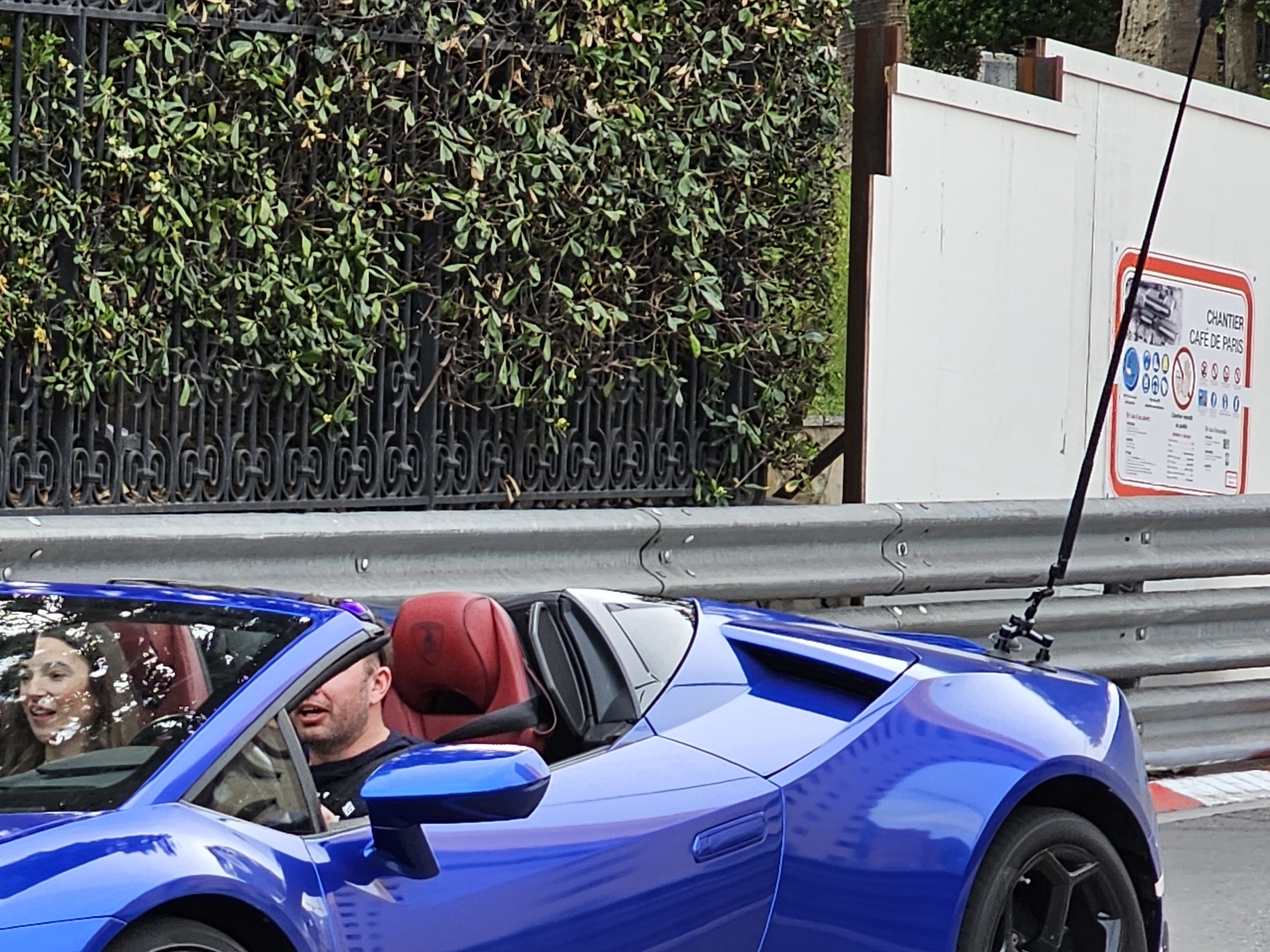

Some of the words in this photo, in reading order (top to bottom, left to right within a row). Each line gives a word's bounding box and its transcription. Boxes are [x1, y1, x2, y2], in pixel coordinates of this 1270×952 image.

[1206, 309, 1244, 331] CHANTIER
[1189, 328, 1209, 347] CAFÉ
[1210, 333, 1221, 349] DE
[1222, 336, 1244, 354] PARIS
